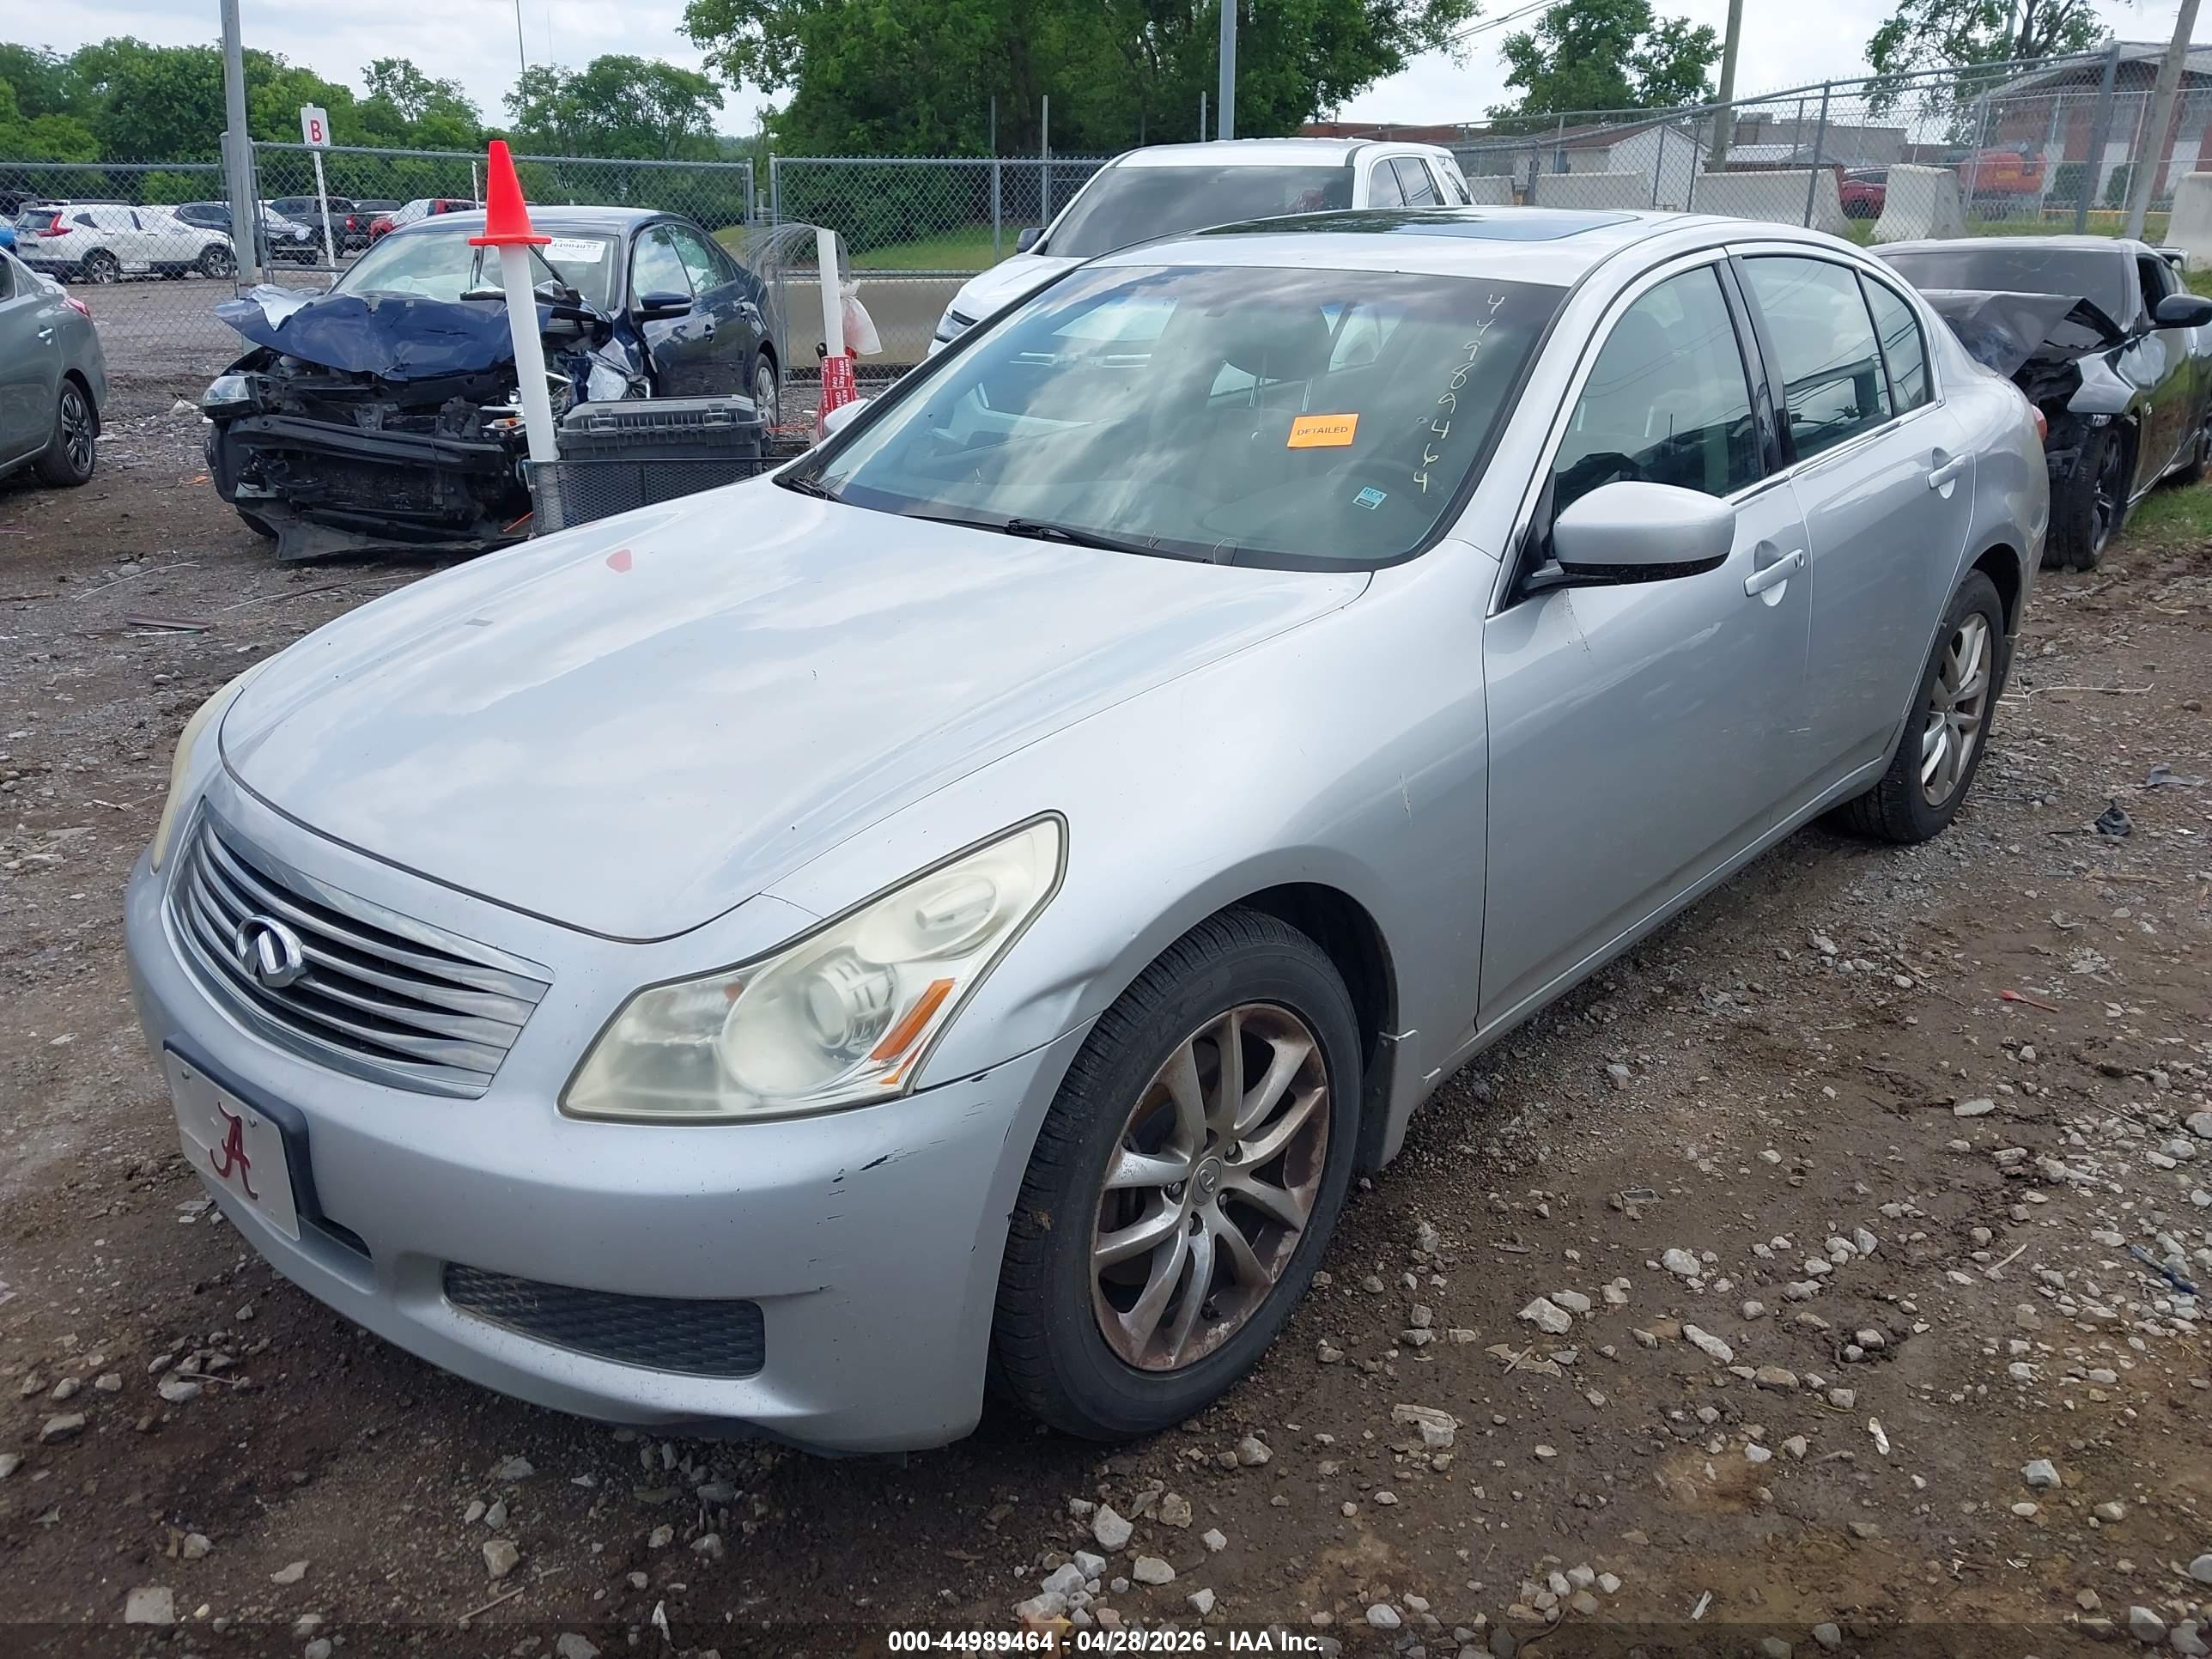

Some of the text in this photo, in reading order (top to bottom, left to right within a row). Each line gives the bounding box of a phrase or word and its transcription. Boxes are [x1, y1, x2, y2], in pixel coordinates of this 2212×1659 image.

[310, 119, 322, 142] B
[1413, 295, 1504, 494] 44989464
[1297, 426, 1348, 435] DETAILED
[210, 1101, 258, 1200] A
